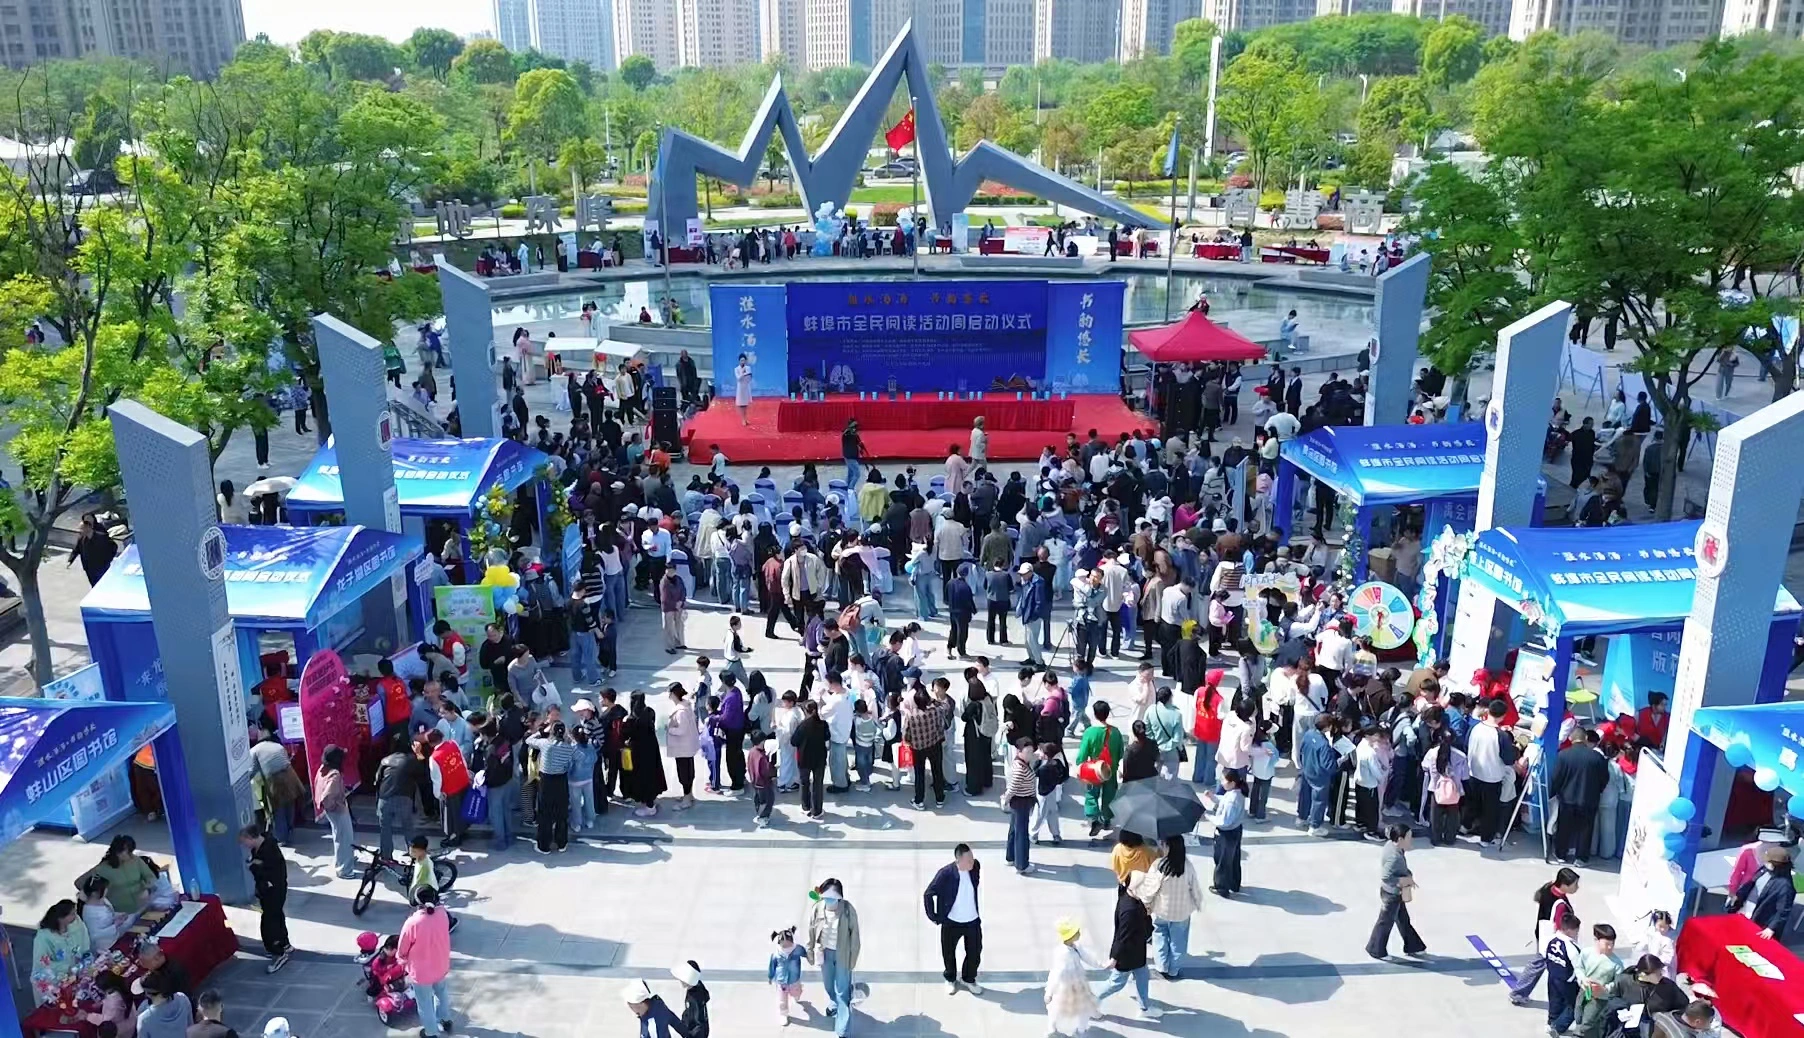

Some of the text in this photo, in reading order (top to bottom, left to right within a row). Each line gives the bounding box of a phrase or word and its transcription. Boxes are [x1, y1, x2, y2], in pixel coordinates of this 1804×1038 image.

[803, 313, 1033, 332] 蚌埠市全民阅读活动周启动仪式
[25, 727, 118, 804] 蚌山区图书馆
